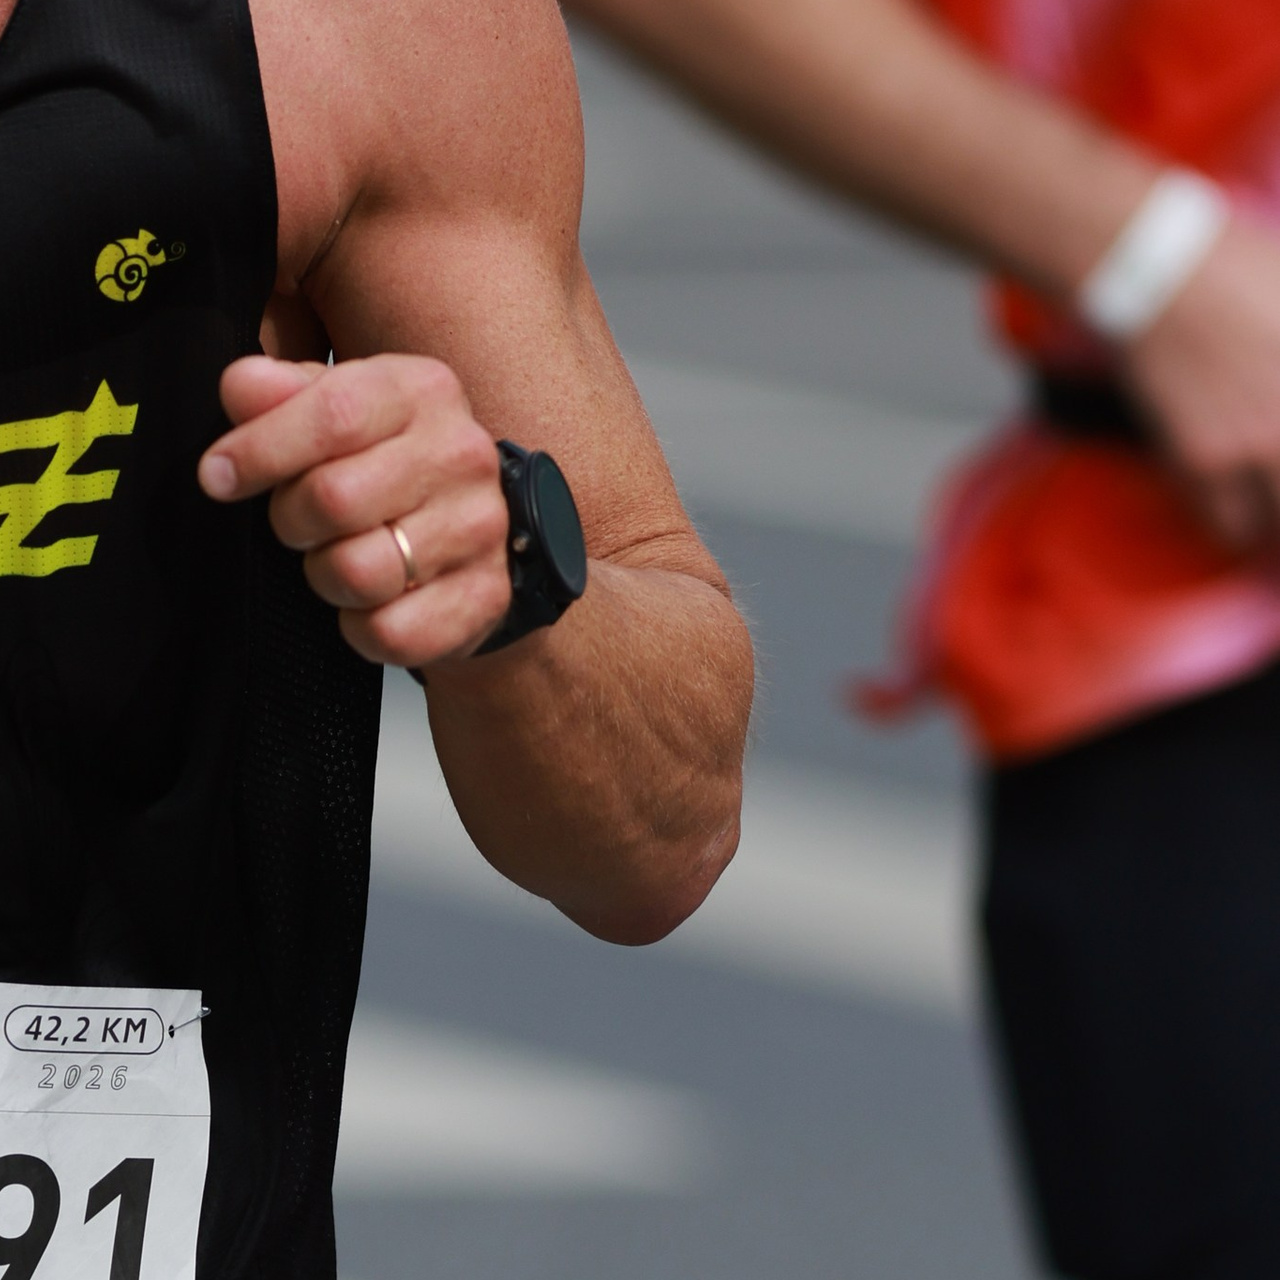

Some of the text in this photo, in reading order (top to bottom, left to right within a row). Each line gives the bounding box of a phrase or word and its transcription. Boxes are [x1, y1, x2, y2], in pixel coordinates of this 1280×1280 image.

[24, 1015, 148, 1046] 42,2 КМ
[38, 1063, 128, 1090] 2026
